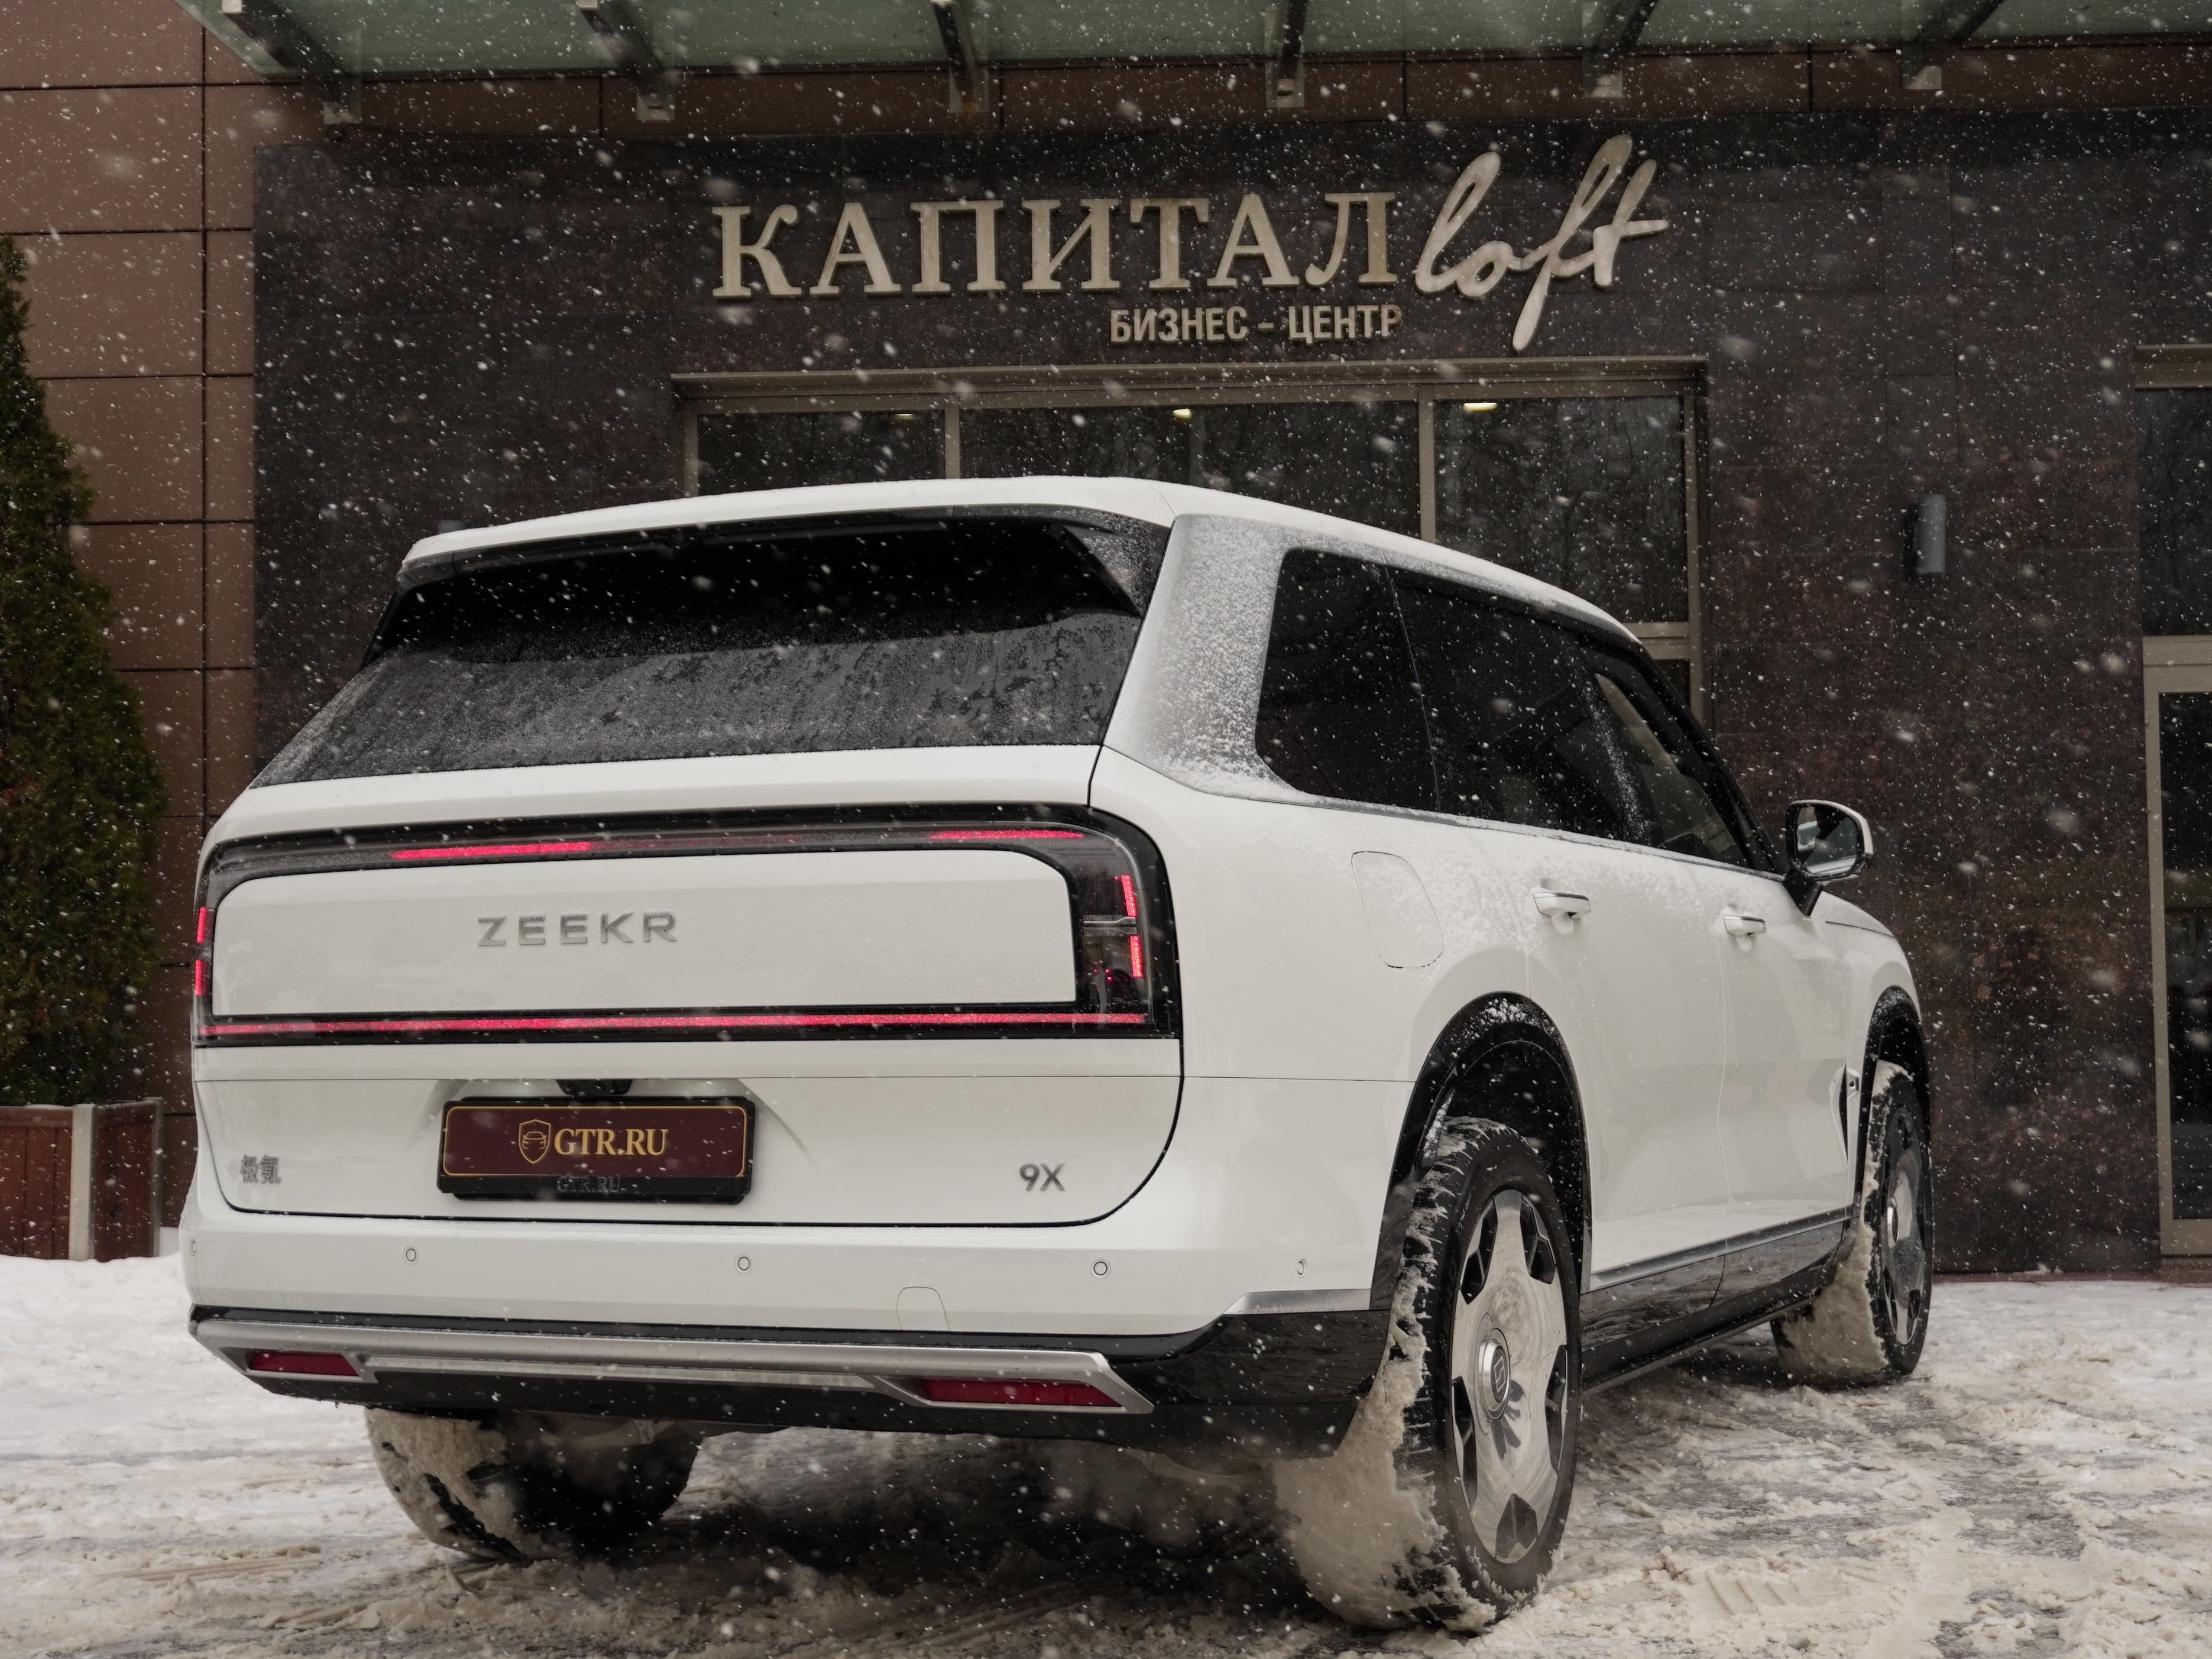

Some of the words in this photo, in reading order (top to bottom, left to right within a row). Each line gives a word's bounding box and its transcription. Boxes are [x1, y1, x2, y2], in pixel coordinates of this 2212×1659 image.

[711, 191, 1398, 298] КАПИТАЛ
[1414, 134, 1669, 352] loft
[477, 909, 678, 947] ZEEKR
[554, 1128, 669, 1156] GTR.RU
[556, 1175, 621, 1193] GTR.RU
[1019, 1162, 1065, 1191] 9X
